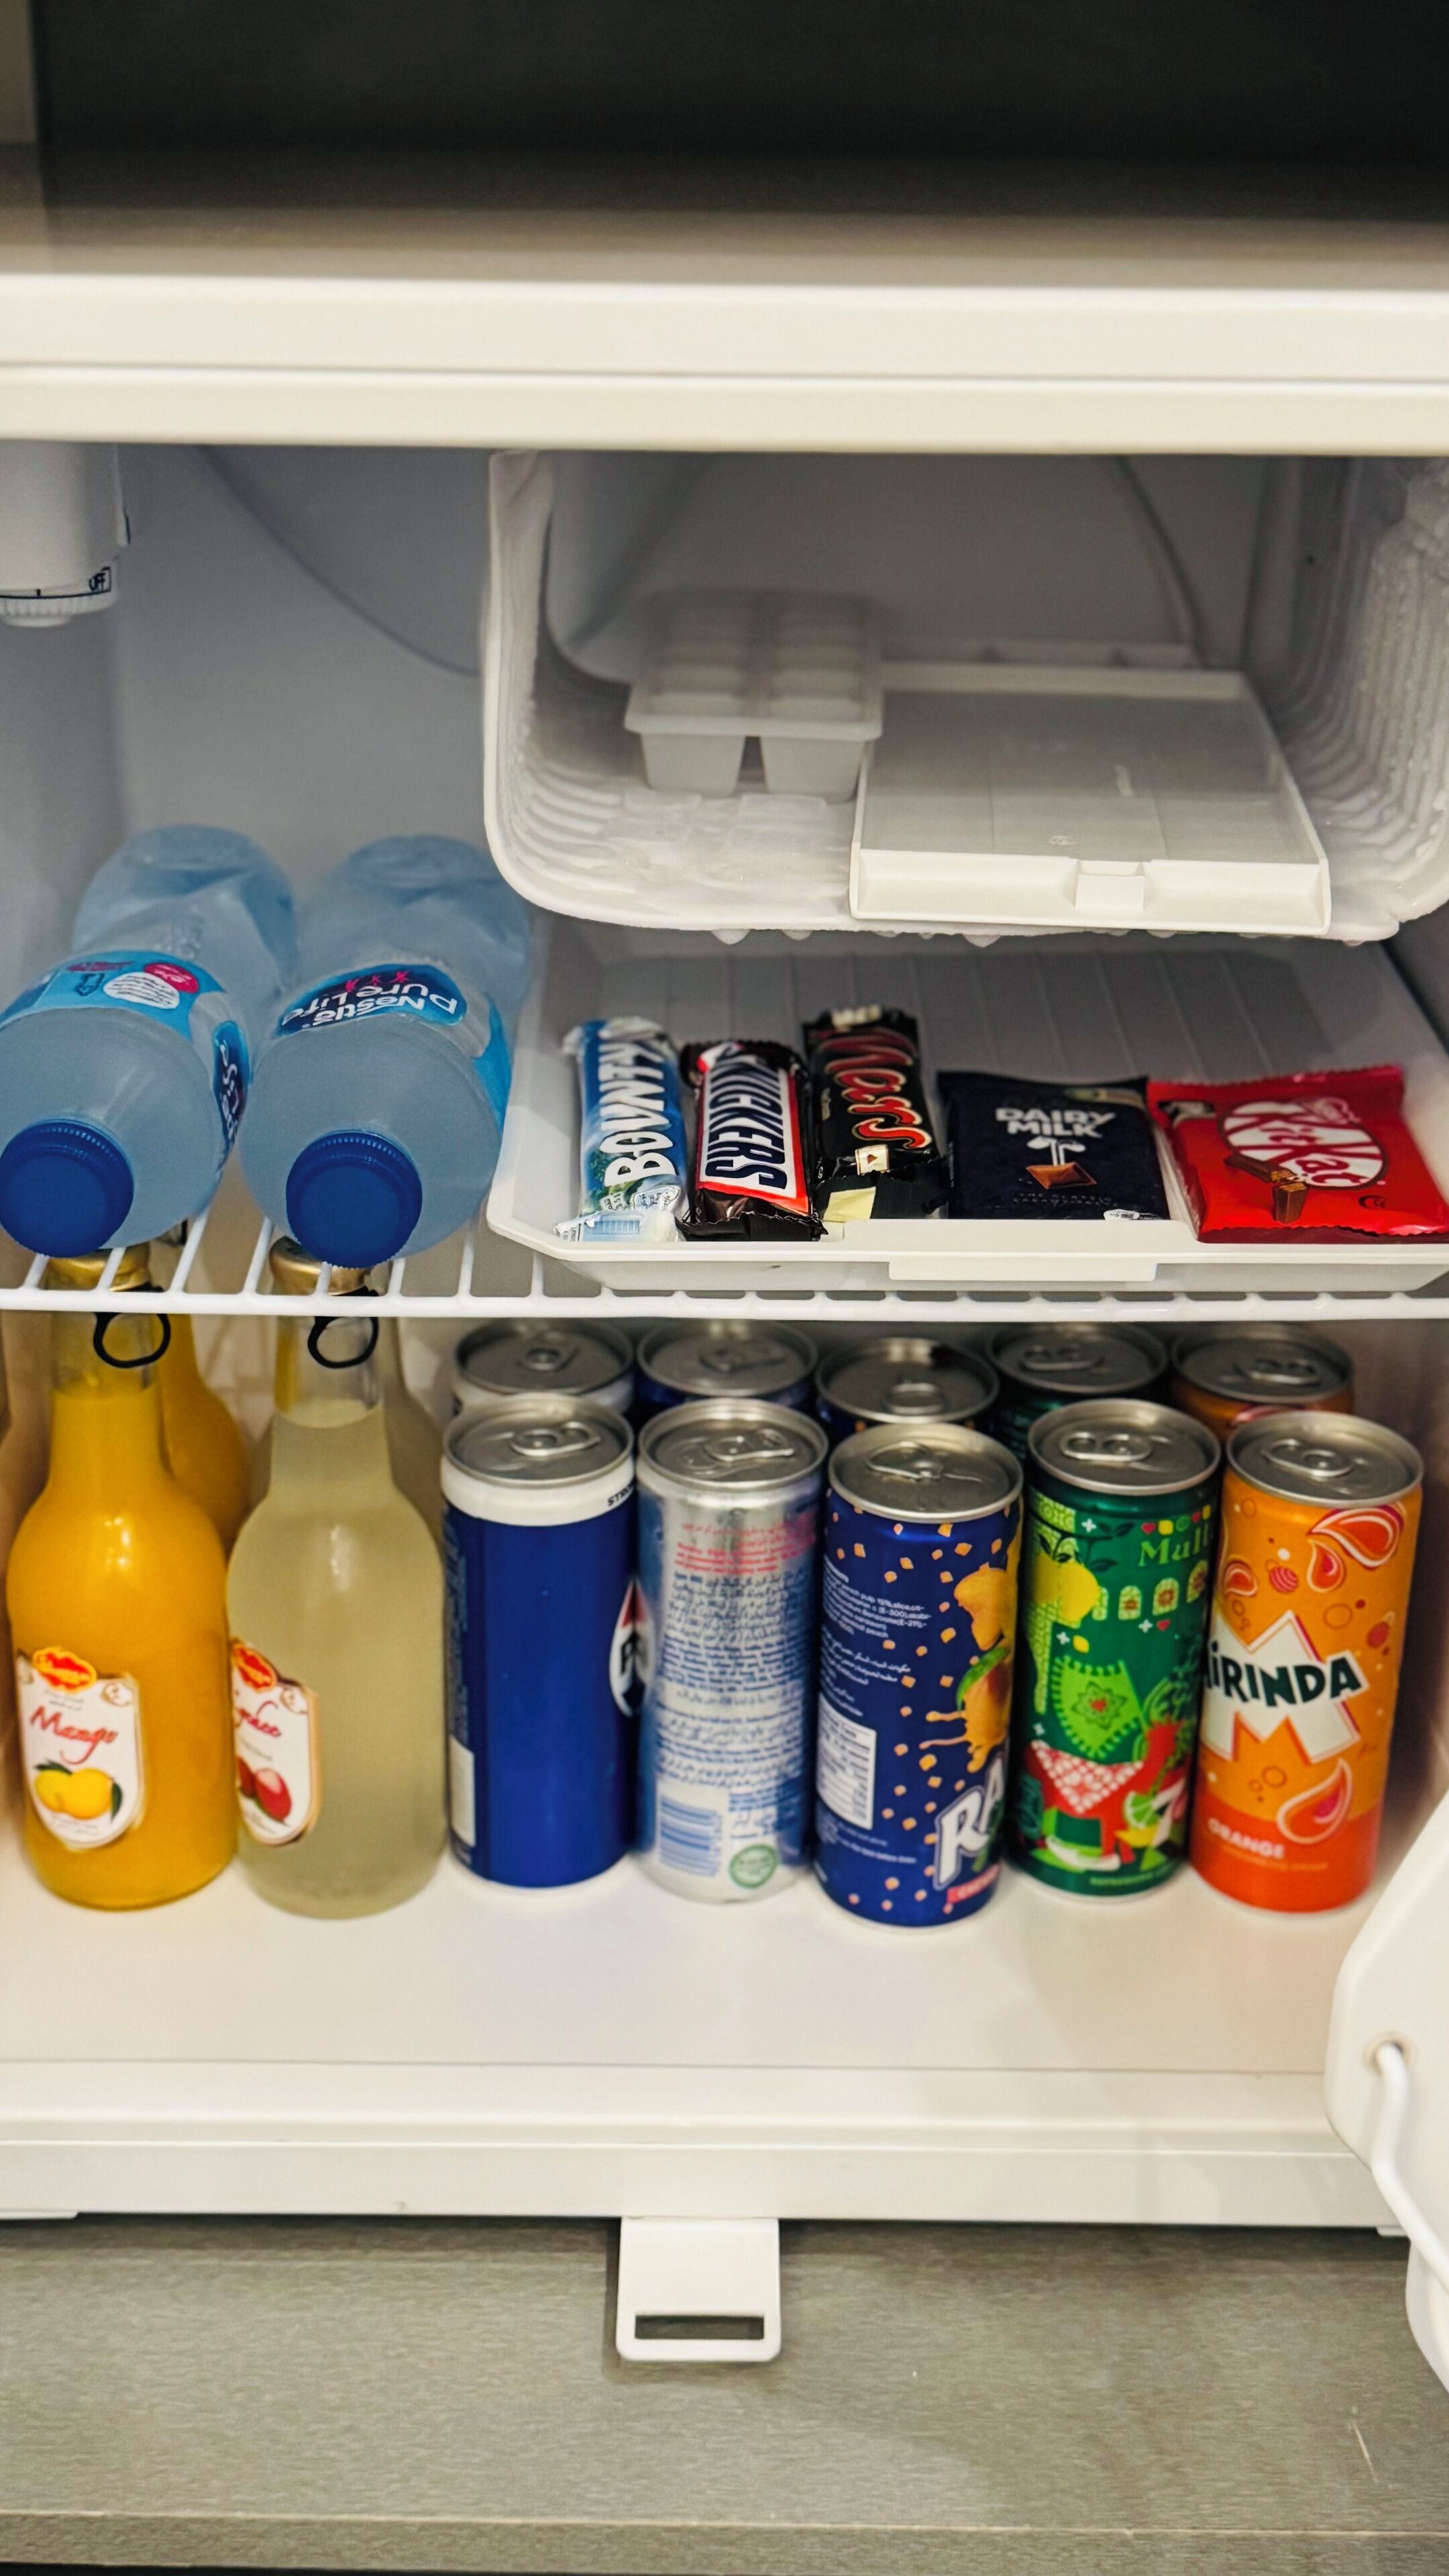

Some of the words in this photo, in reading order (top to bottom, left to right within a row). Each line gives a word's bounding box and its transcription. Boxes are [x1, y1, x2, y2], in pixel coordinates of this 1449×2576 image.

[598, 1042, 677, 1187] BOUNTY
[704, 1047, 788, 1190] SNICKERS
[816, 1027, 932, 1149] Mars
[996, 1108, 1116, 1126] DAIRY
[1007, 1121, 1104, 1138] MILK
[1206, 1641, 1362, 1707] iRINDA
[30, 1705, 119, 1766] Mango
[1208, 1817, 1285, 1860] ORANGE
